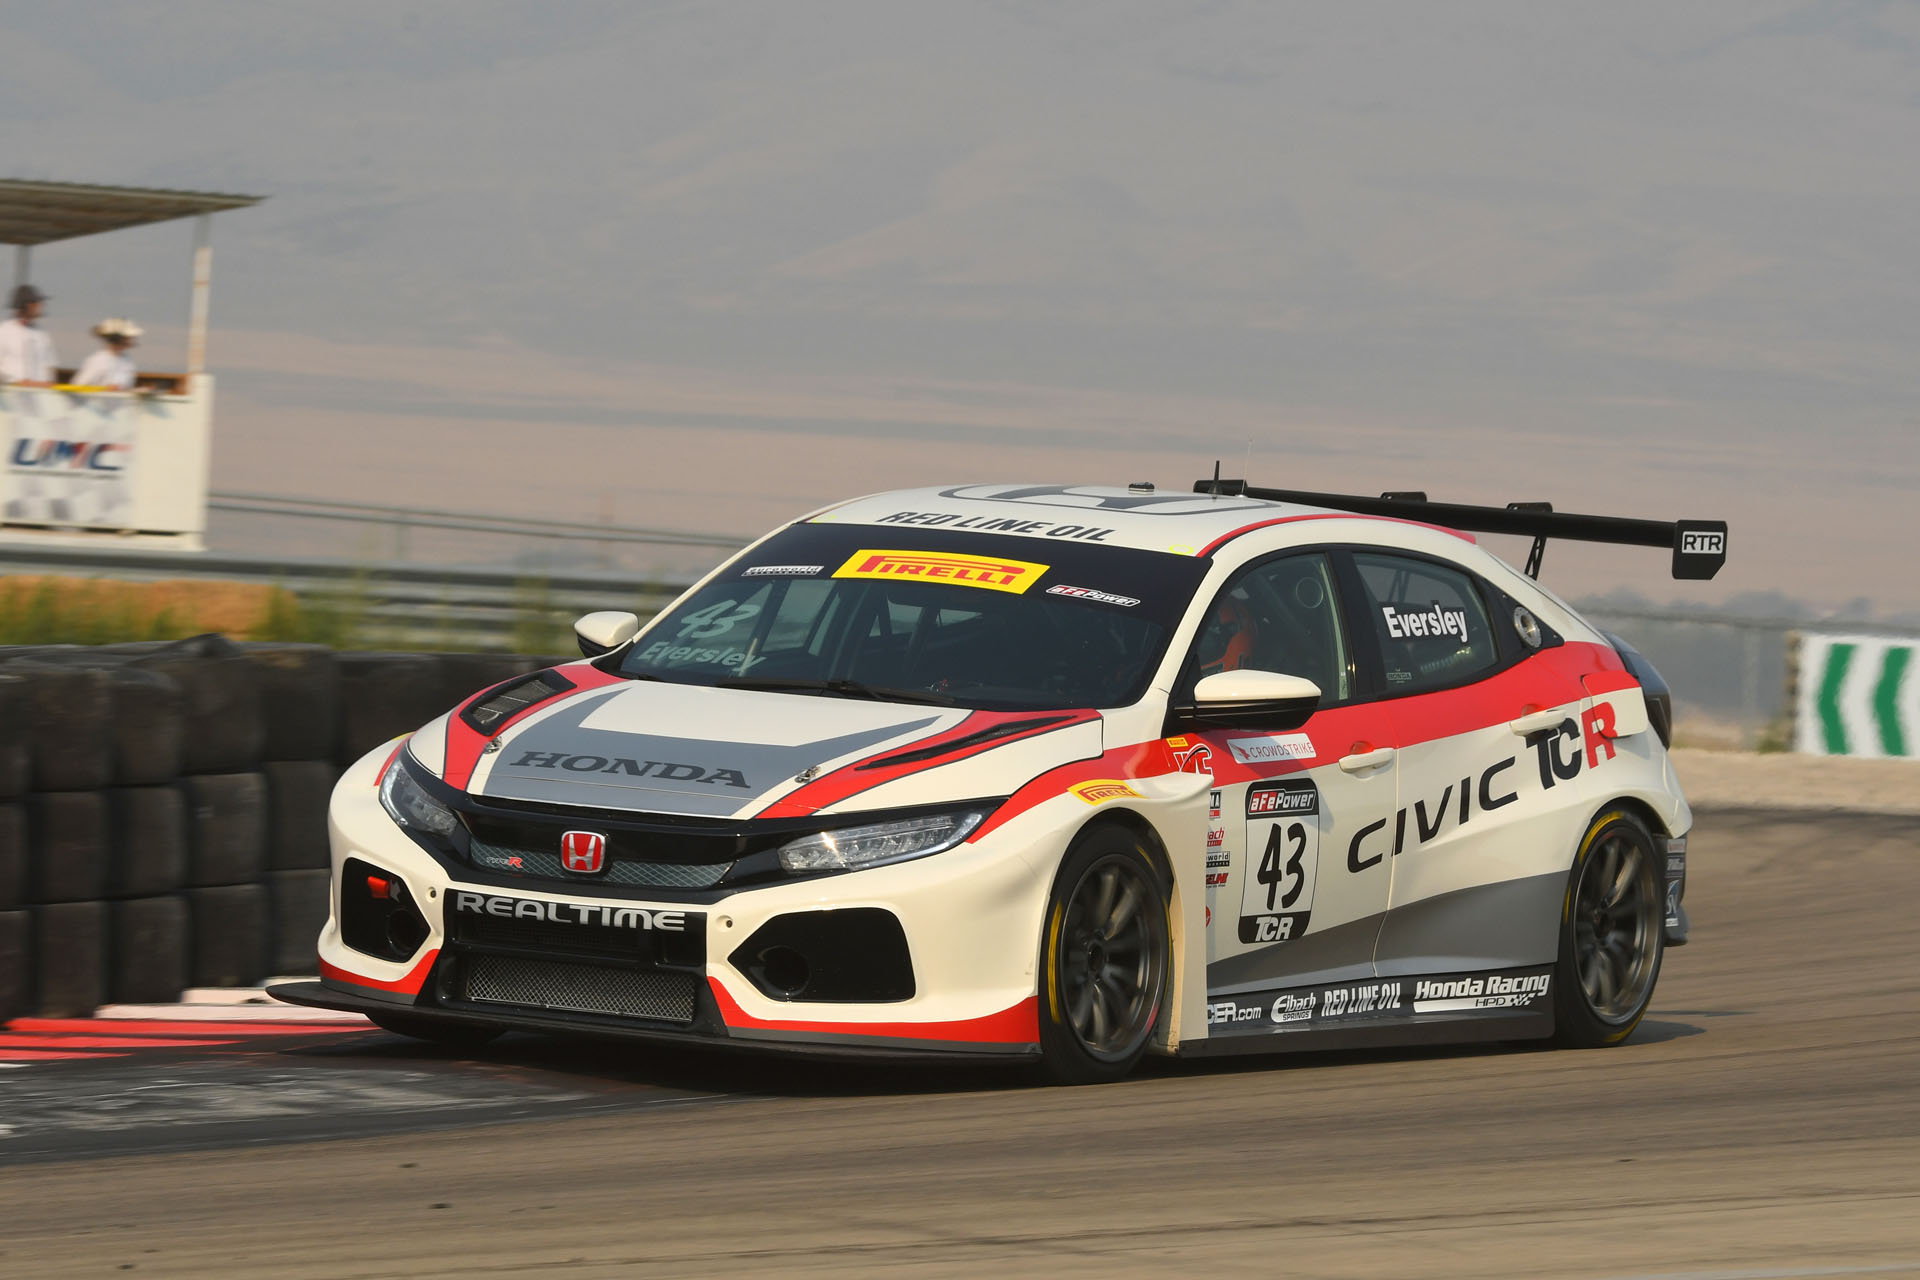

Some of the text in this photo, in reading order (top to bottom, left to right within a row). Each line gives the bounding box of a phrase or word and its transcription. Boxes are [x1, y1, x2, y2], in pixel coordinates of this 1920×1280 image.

[11, 438, 133, 470] UMC
[876, 511, 1117, 541] RED LINE OIL
[1683, 533, 1723, 551] RTR
[857, 555, 1025, 585] PIRELLI
[677, 600, 760, 638] 43
[1383, 604, 1468, 643] Eversley
[637, 641, 767, 672] Eversley
[1250, 742, 1314, 758] CROWDSTRIKE
[510, 751, 751, 788] HONDA
[1348, 702, 1618, 873] CIVIC TCR
[1257, 822, 1307, 911] 43
[456, 892, 685, 931] REALTIME
[1255, 916, 1294, 942] TCR
[1321, 983, 1401, 1016] RED LINE OIL
[1414, 975, 1551, 999] Honda Racing
[1207, 1002, 1262, 1024] CER.com
[1271, 992, 1316, 1022] Eibach
[1283, 1011, 1310, 1020] SPRINGS
[1475, 998, 1505, 1007] HPD
